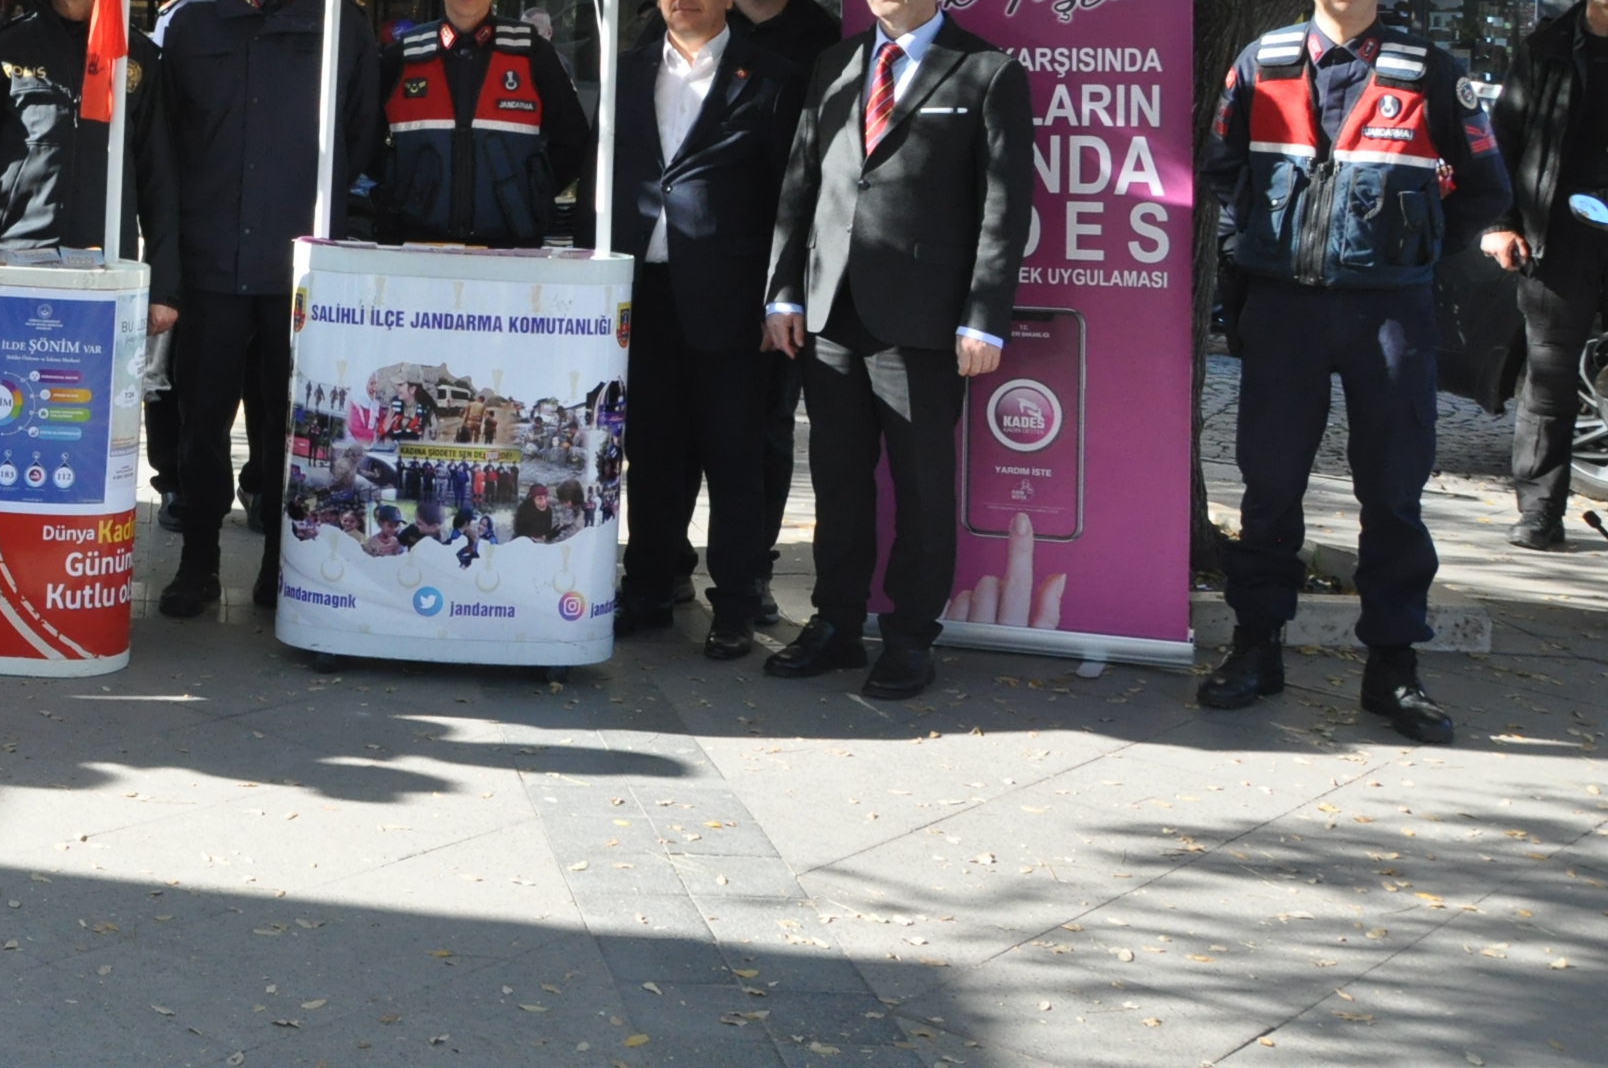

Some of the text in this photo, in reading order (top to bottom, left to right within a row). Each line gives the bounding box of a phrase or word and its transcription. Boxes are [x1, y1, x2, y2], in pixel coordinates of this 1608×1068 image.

[499, 100, 534, 110] JANDARMA
[1364, 128, 1411, 139] JANDARMA
[1033, 135, 1165, 197] NDA
[1019, 267, 1168, 288] EK UYGULAMASI
[311, 303, 611, 335] SALİHLİ İLÇE JANDARMA KOMUTANLIĞI
[1, 340, 26, 351] İLDE
[29, 337, 80, 355] ŞÖNİM
[84, 345, 102, 354] VAR
[1003, 415, 1045, 429] KADES
[0, 469, 14, 478] 183
[56, 471, 71, 480] 112
[995, 465, 1052, 477] YARDIM İSTE
[42, 524, 95, 542] Dünya
[65, 551, 133, 577] Günün
[45, 578, 133, 609] Kutlu ol
[284, 582, 356, 609] jandarmagnk
[449, 600, 515, 619] jandarma
